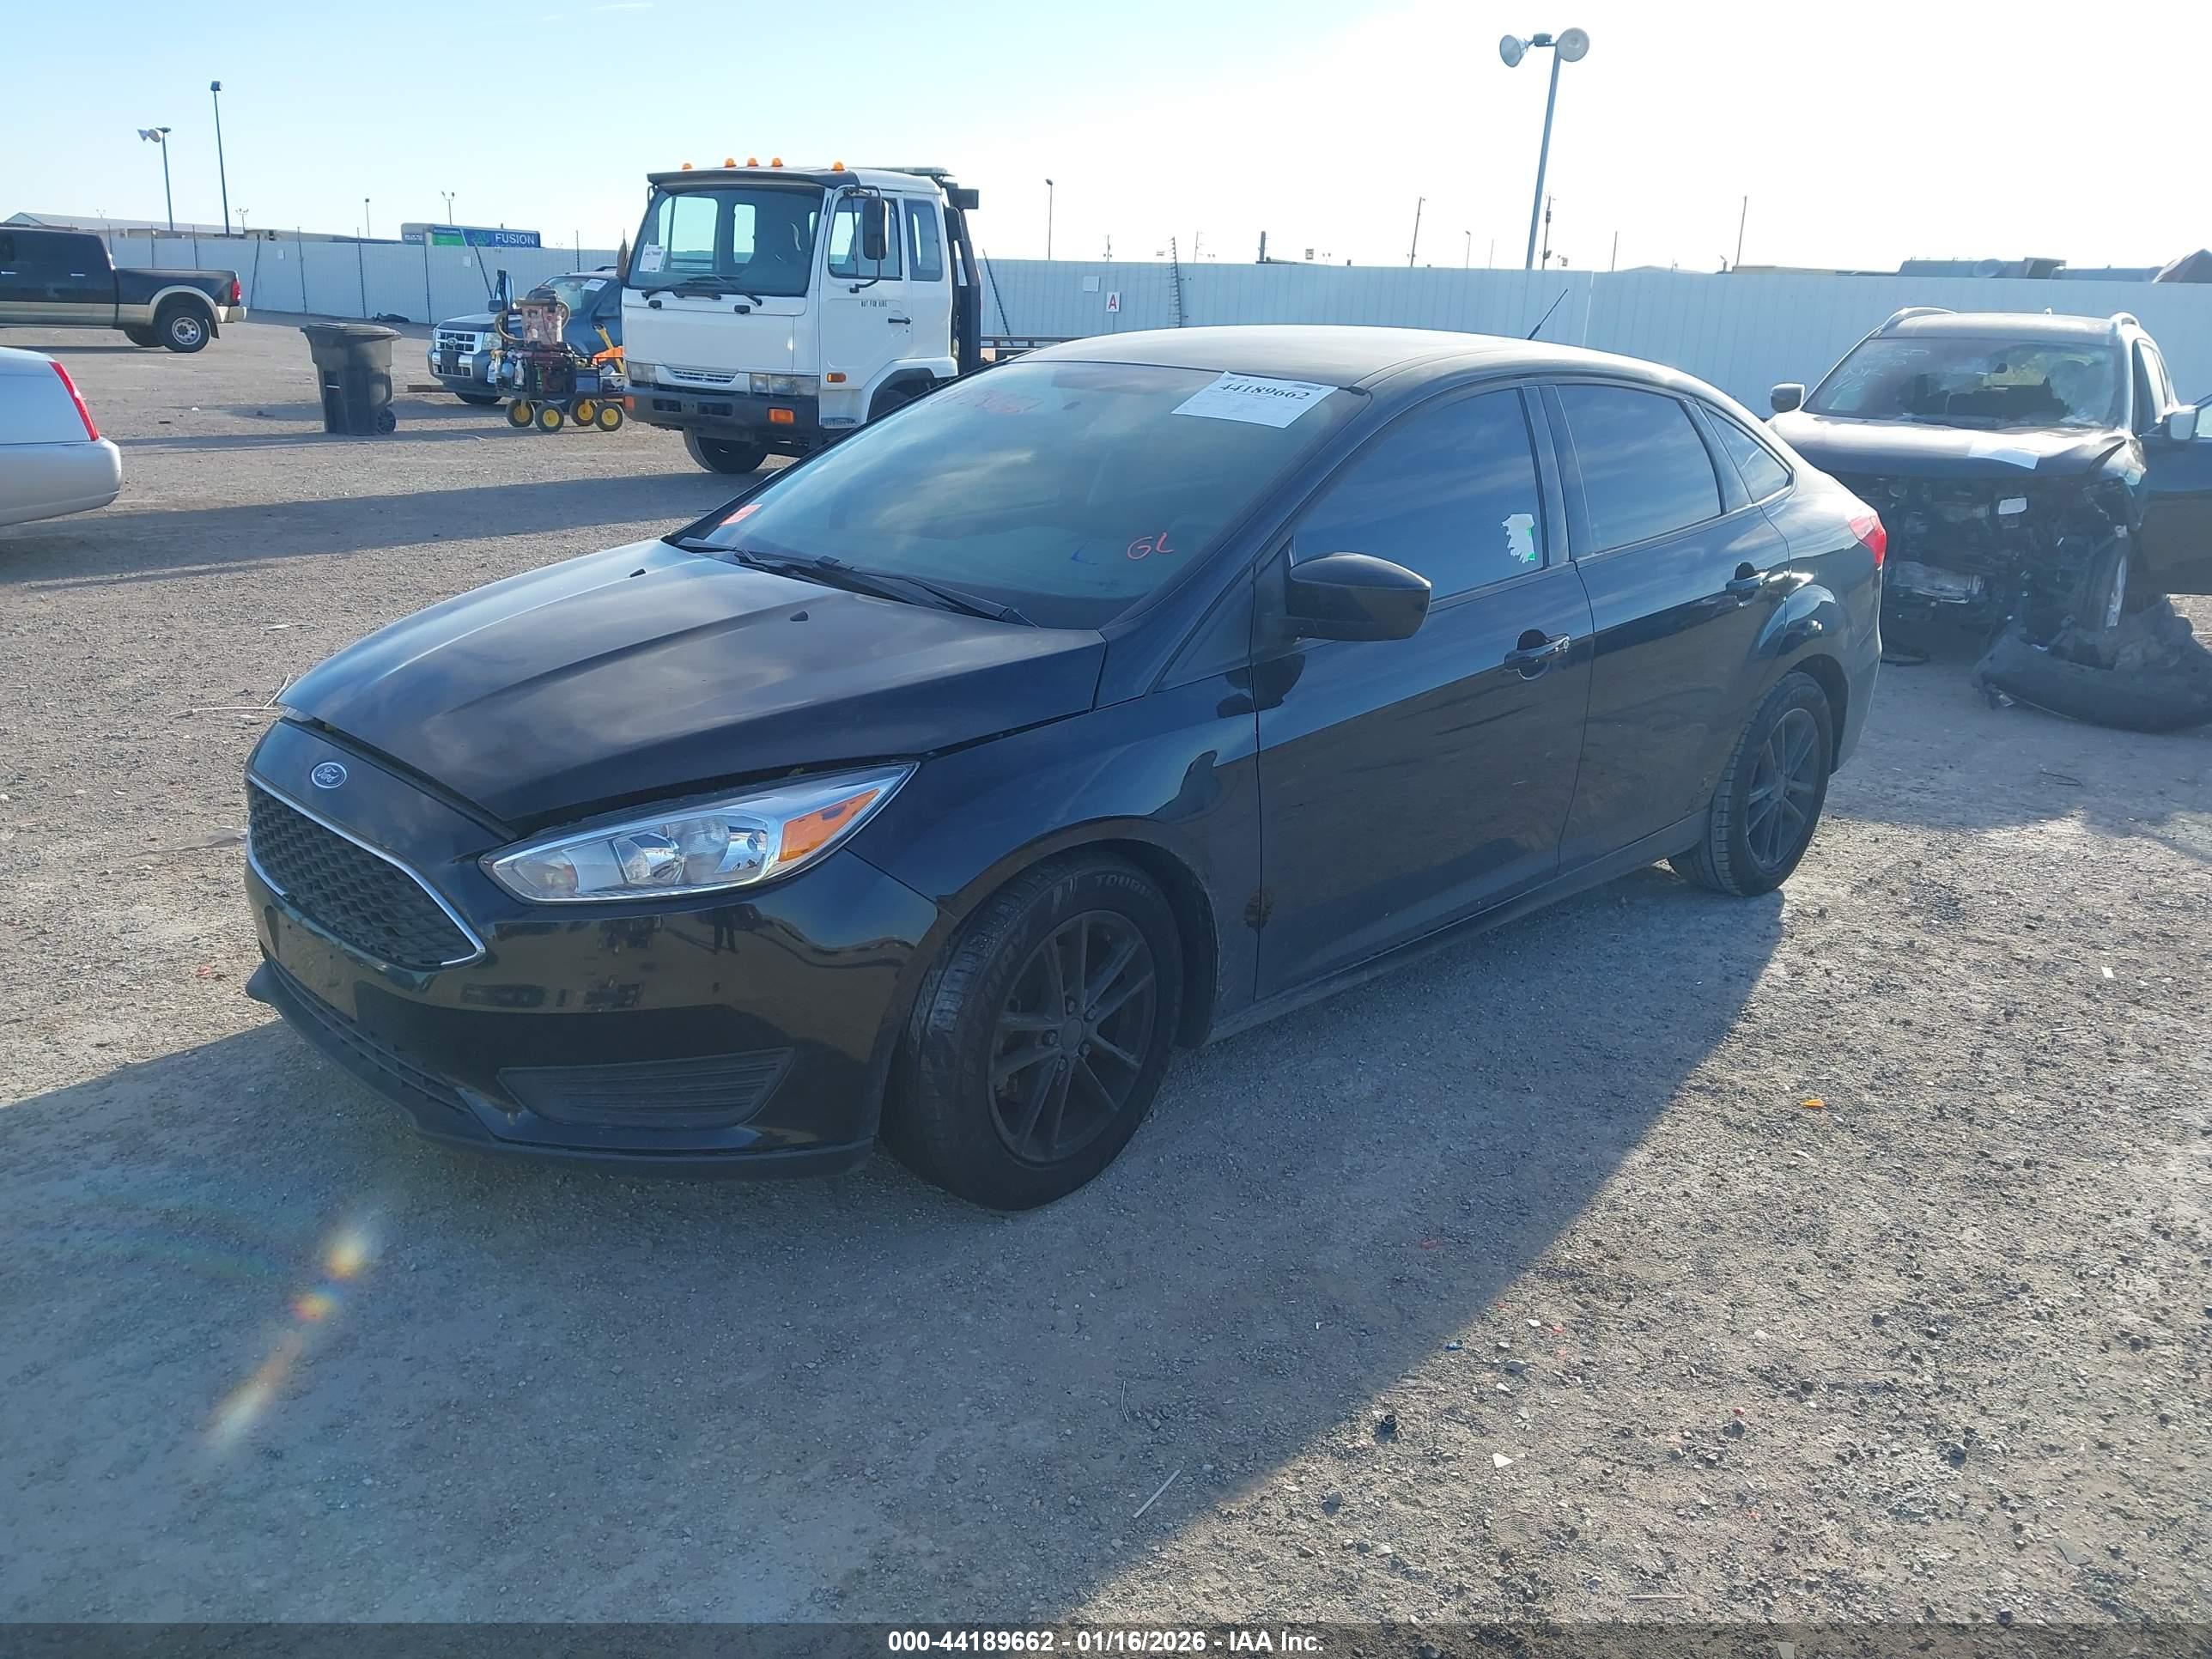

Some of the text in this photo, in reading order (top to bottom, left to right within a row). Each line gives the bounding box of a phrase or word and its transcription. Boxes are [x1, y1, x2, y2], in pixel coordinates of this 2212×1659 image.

[495, 233, 535, 245] FUSION
[1108, 295, 1117, 310] A
[1219, 383, 1311, 400] 44189662
[1127, 532, 1175, 560] GL
